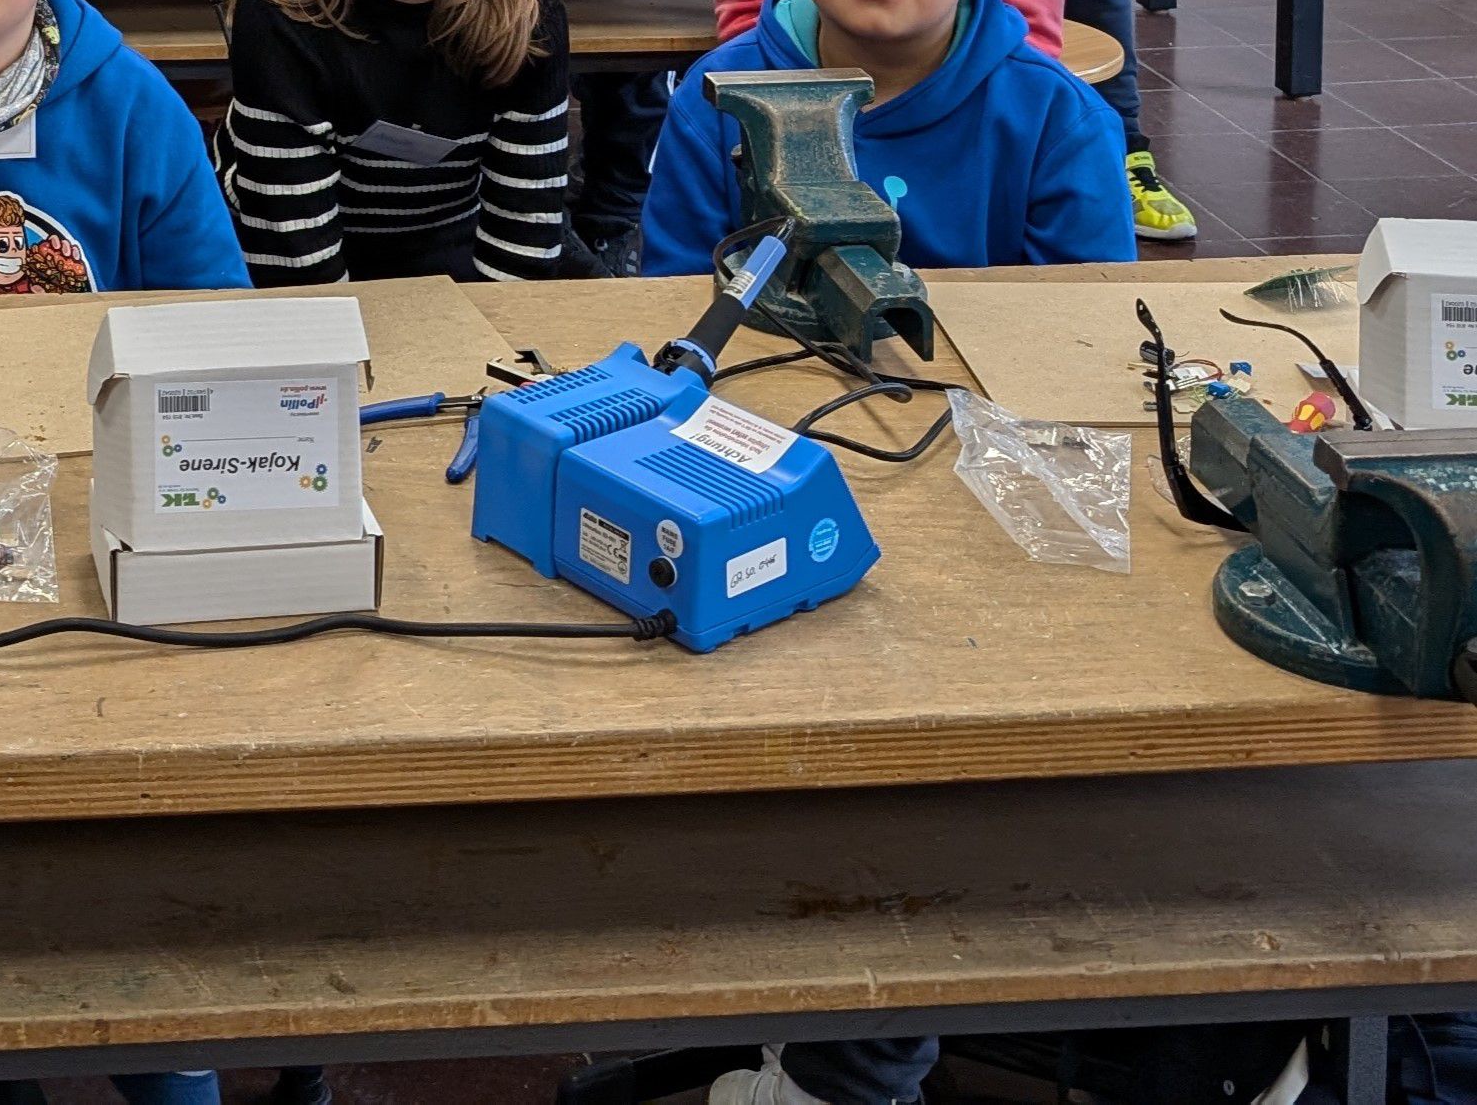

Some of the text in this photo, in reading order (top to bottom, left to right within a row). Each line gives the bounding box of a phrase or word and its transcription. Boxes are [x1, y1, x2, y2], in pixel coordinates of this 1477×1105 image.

[280, 398, 316, 410] Pollin
[689, 432, 753, 464] Achtung!
[179, 452, 301, 475] Kojak-Sirene
